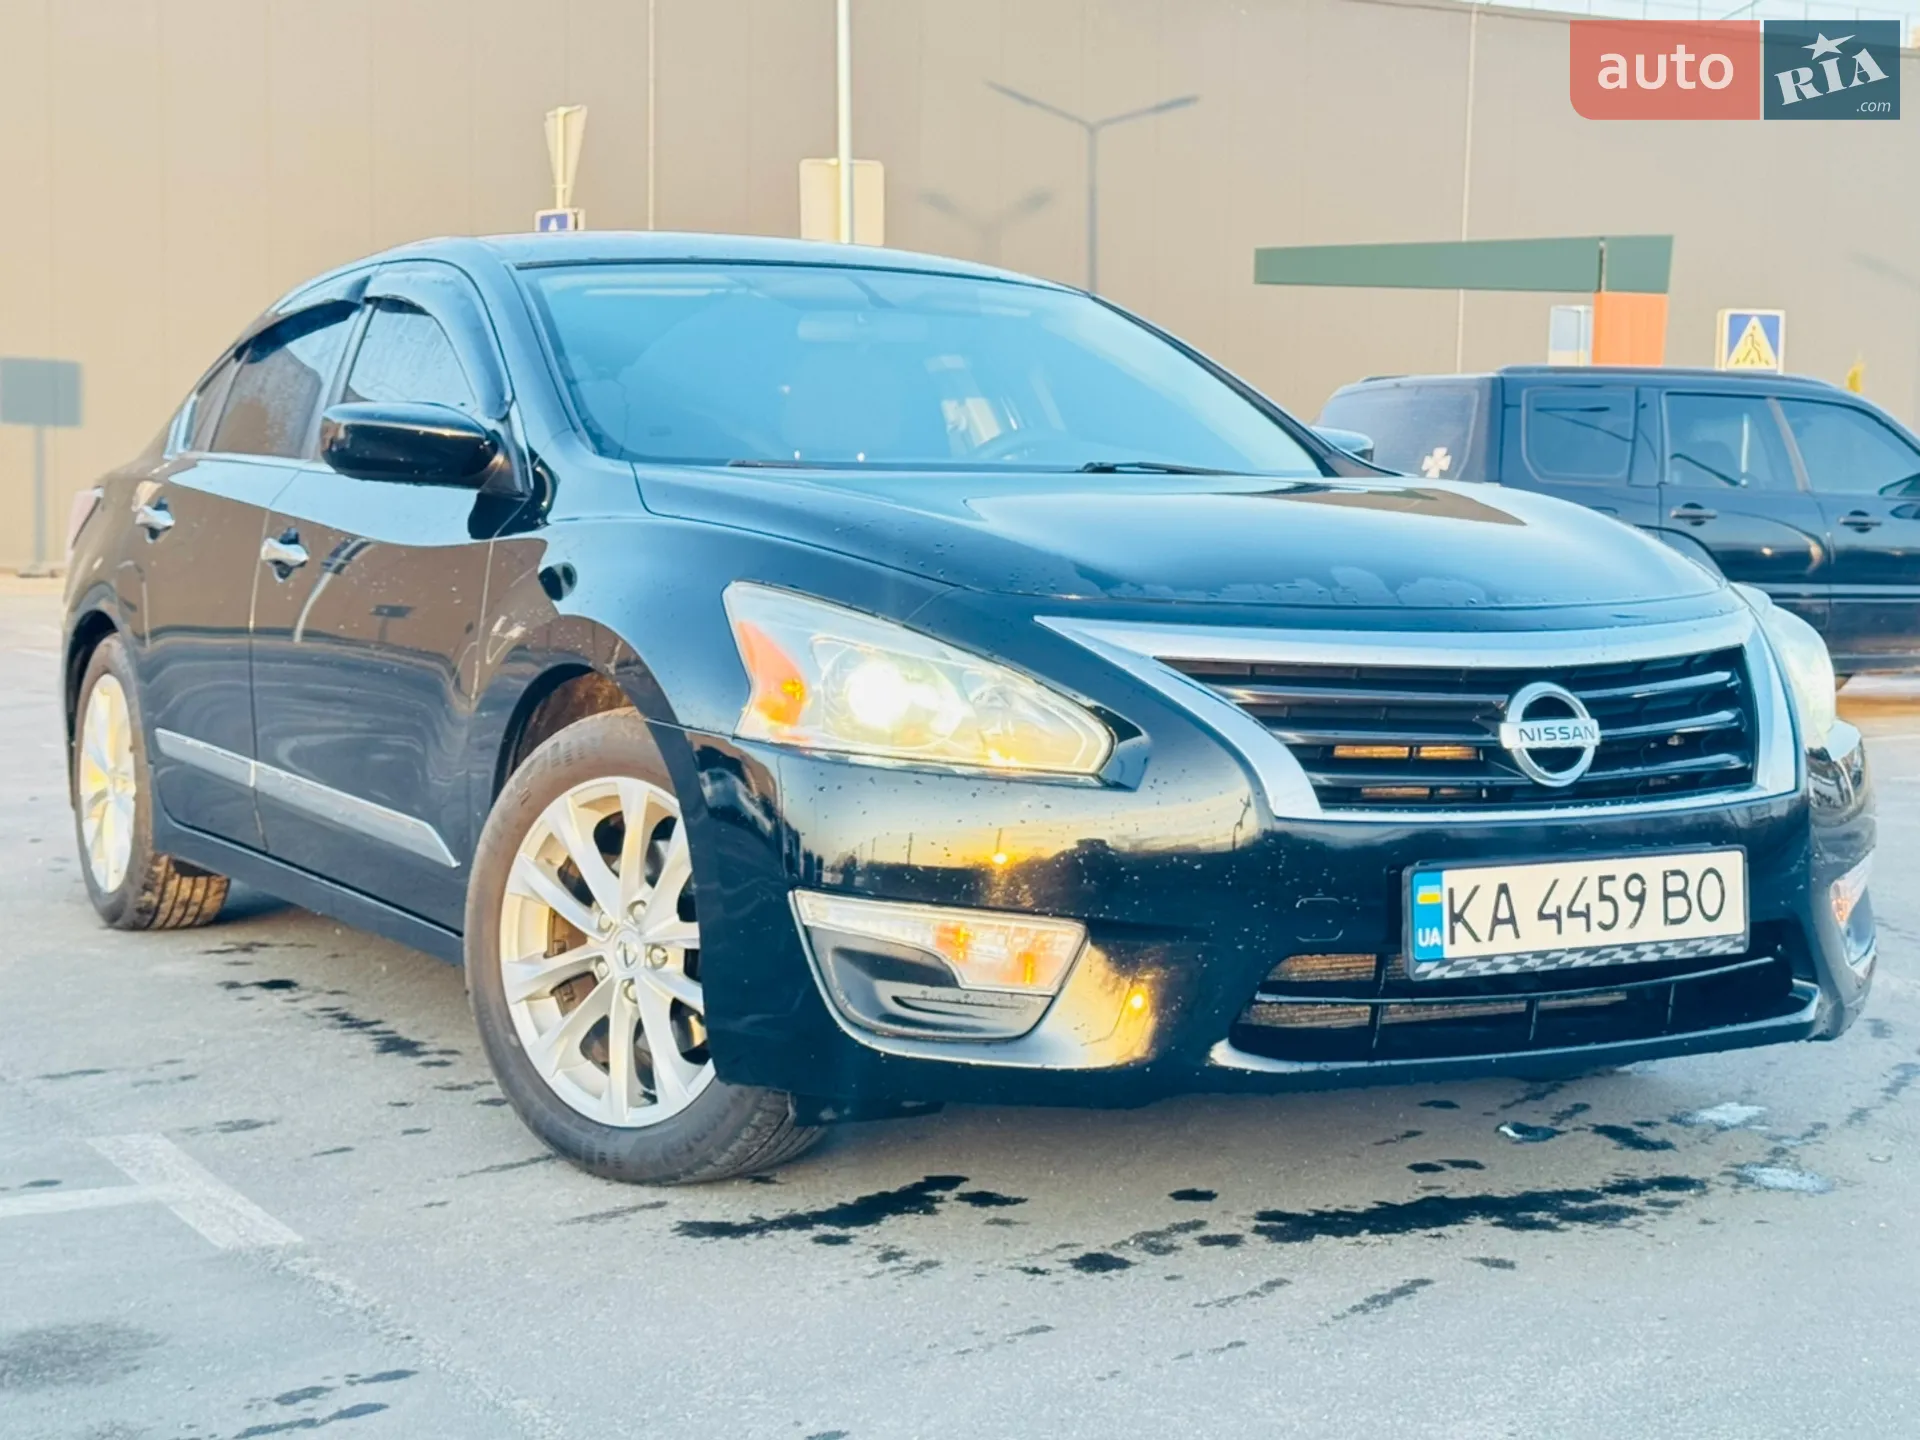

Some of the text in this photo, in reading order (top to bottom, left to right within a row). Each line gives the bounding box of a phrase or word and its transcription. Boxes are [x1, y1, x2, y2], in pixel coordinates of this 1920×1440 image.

[1518, 726, 1595, 742] NISSAN
[1448, 867, 1726, 945] KA 4459 BO
[1417, 926, 1442, 947] UA
